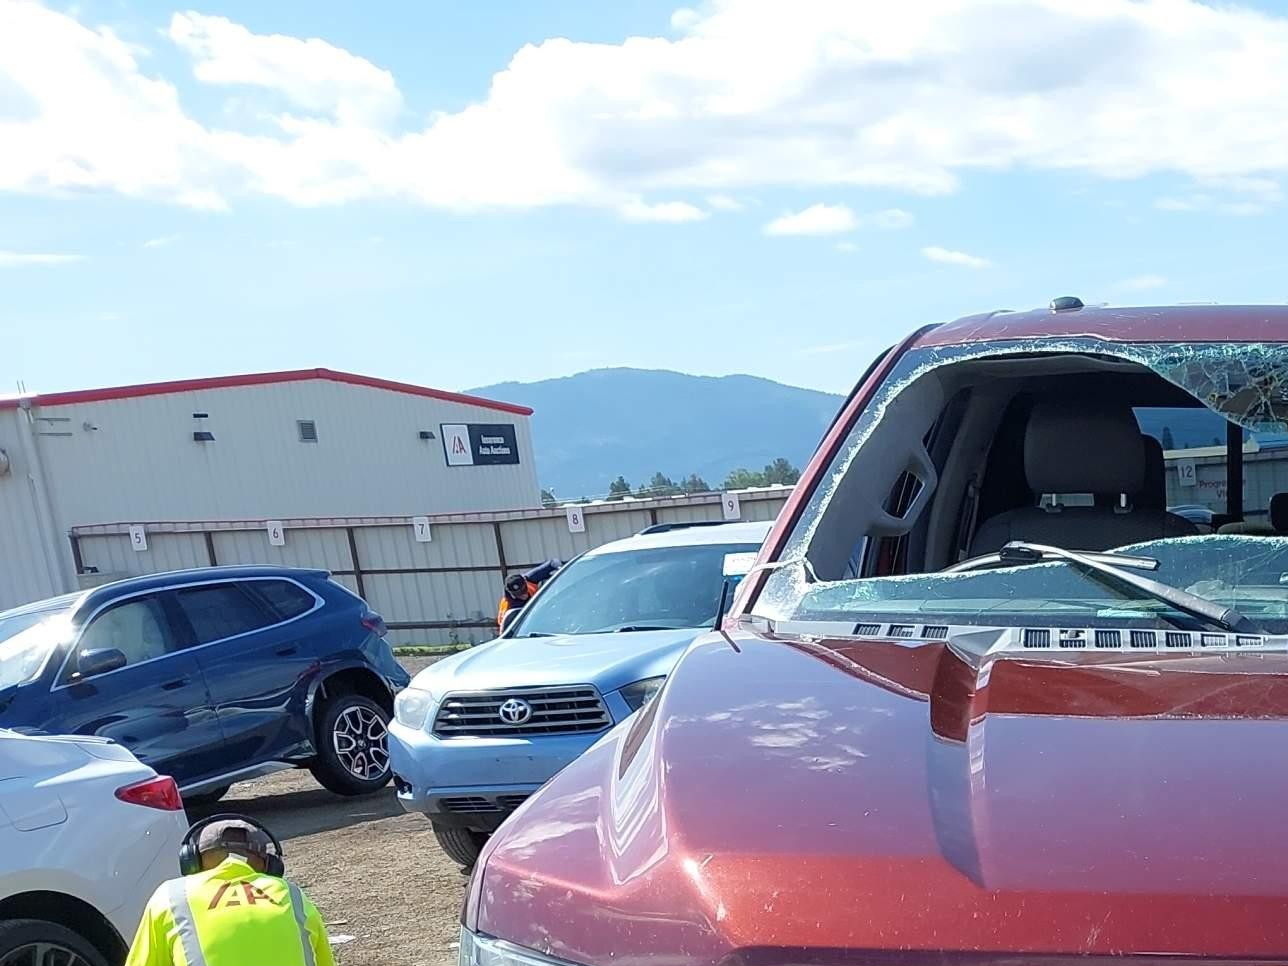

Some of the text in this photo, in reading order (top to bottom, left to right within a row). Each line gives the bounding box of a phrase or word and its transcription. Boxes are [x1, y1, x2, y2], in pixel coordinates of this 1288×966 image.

[1181, 465, 1193, 478] 12
[727, 501, 734, 512] 9
[572, 513, 579, 525] 8
[273, 527, 279, 539] 6
[418, 523, 426, 535] 7
[134, 532, 142, 544] 5
